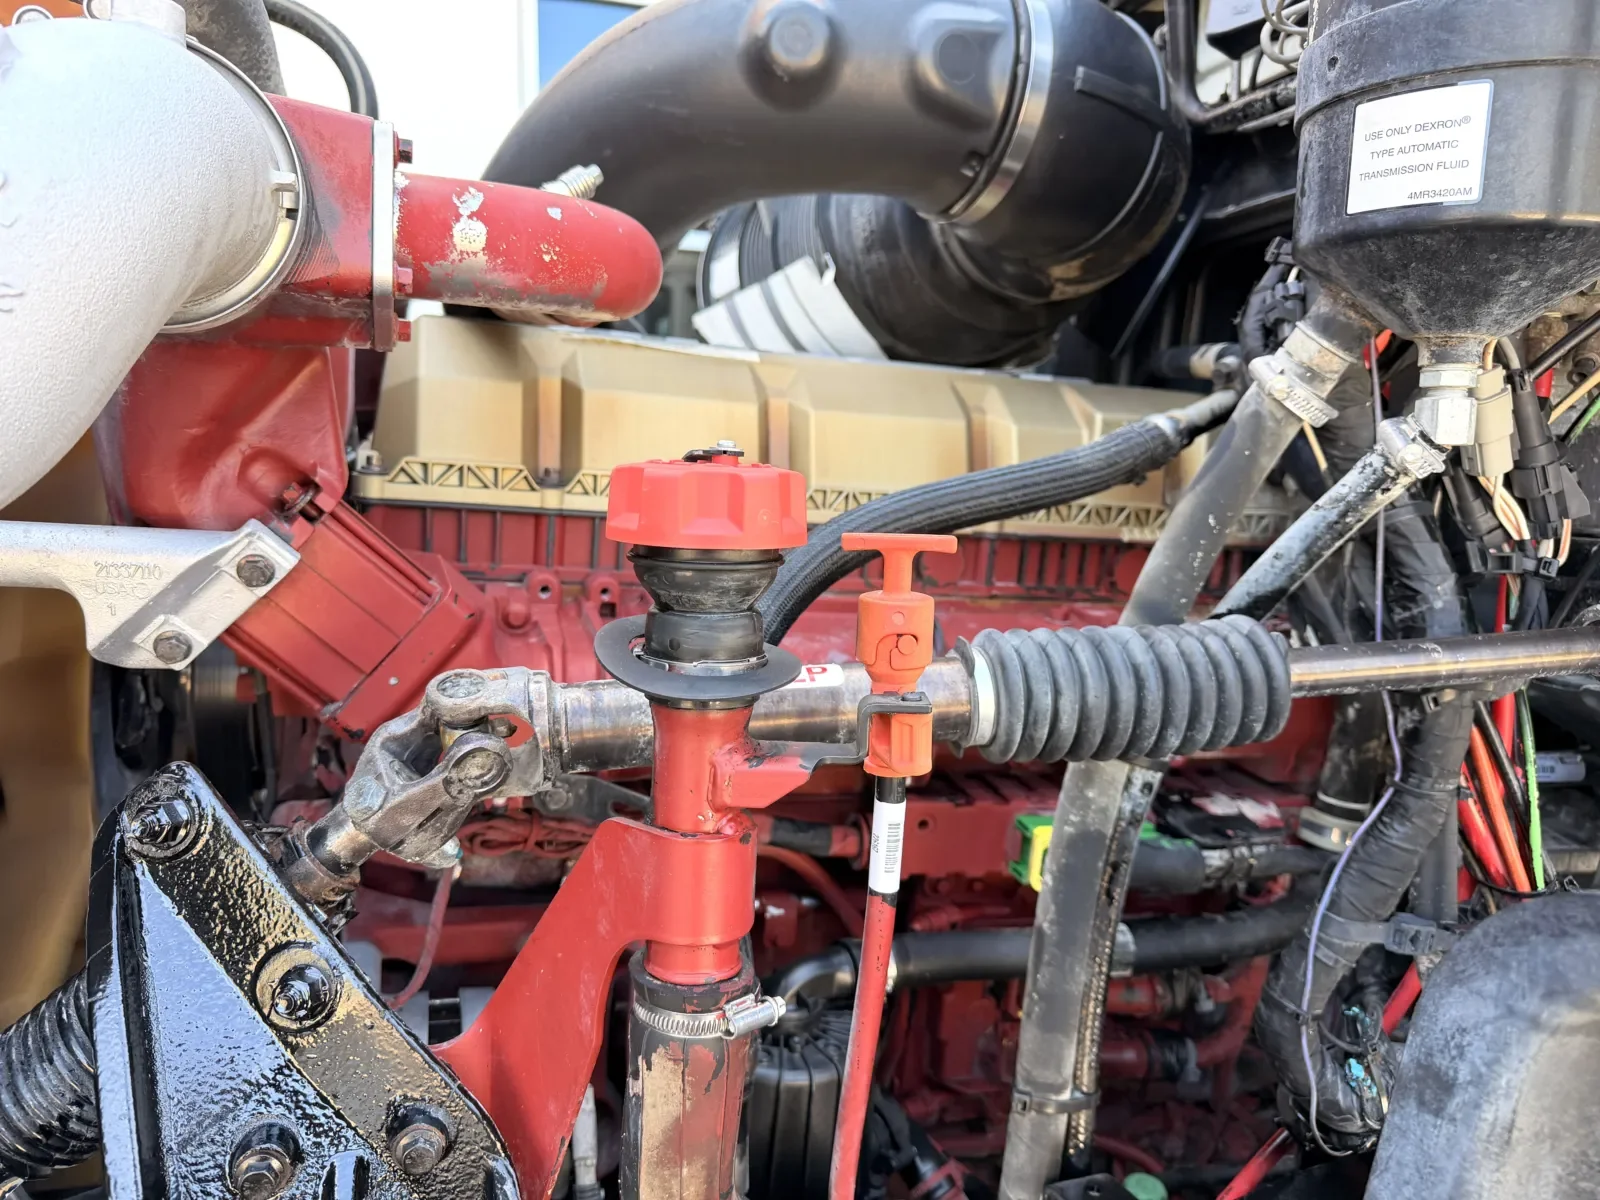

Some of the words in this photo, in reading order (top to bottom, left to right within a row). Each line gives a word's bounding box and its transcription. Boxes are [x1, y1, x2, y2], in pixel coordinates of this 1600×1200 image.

[1364, 130, 1383, 142] USE
[1385, 124, 1412, 138] ONLY
[1414, 115, 1471, 133] DEXRON®
[1370, 148, 1394, 160] TYPE
[1397, 139, 1459, 156] AUTOMATIC
[1359, 162, 1434, 181] TRANSMISSION
[1436, 159, 1469, 171] FLUID
[1407, 187, 1472, 200] 4MR3420AM
